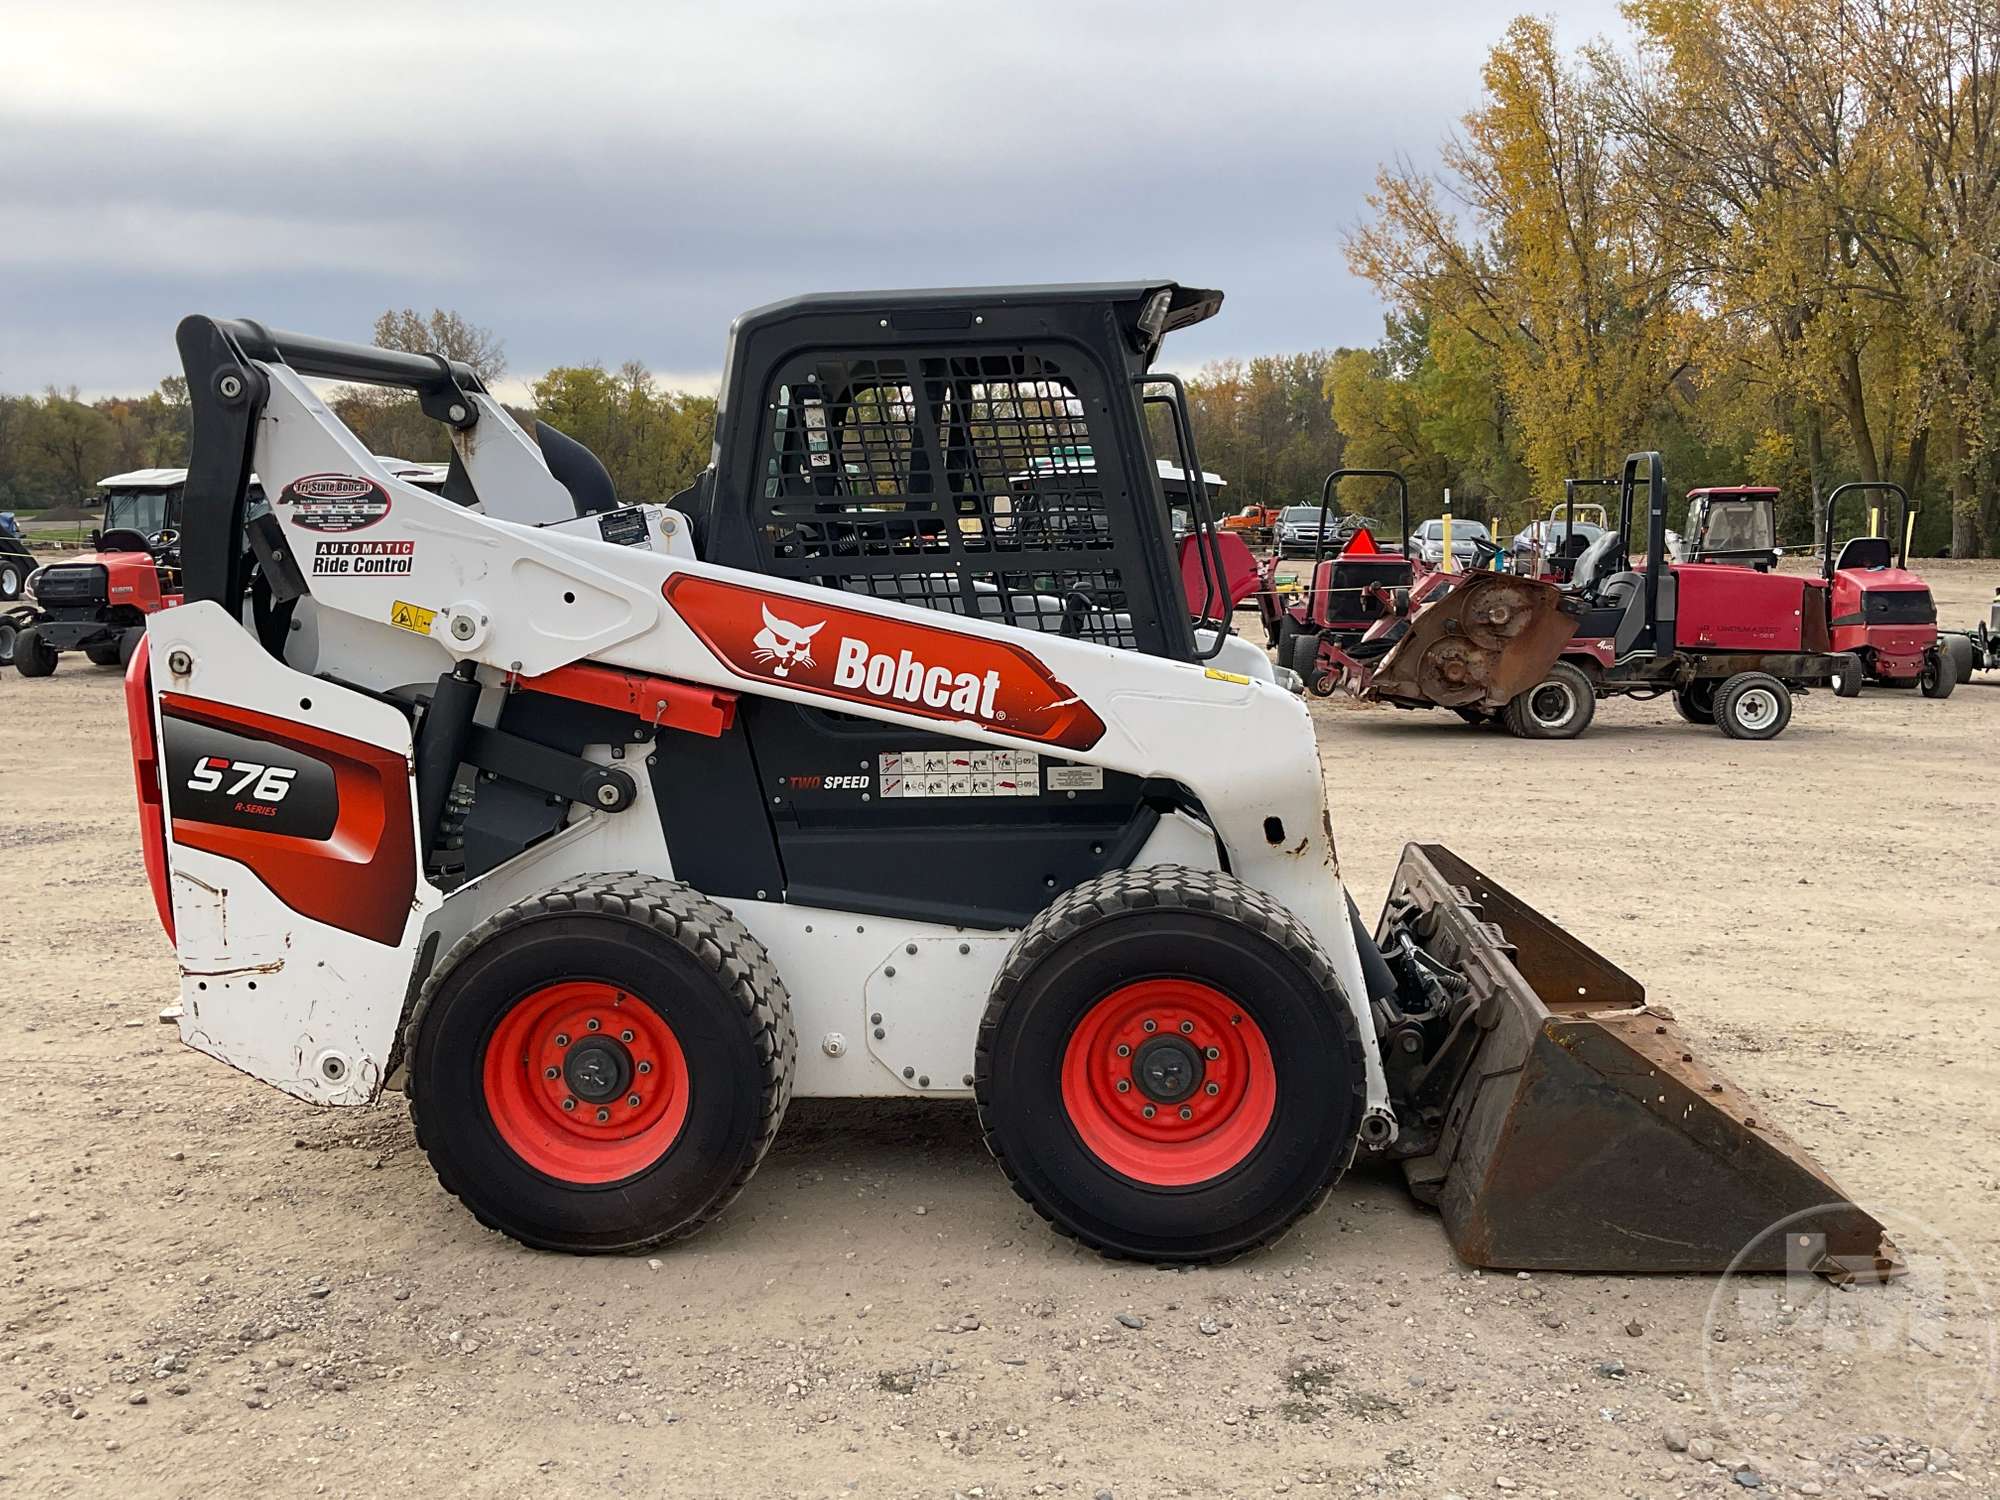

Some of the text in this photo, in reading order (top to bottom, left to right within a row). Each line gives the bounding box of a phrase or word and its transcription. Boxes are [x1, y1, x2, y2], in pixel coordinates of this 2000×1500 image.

[336, 480, 369, 492] Bobcat
[319, 543, 411, 554] AUTOMATIC
[313, 557, 413, 573] Ride Control
[833, 637, 1001, 719] Bobcat
[187, 756, 297, 802] S76
[790, 775, 870, 790] TWO SPEED
[234, 802, 278, 817] R-SERIES
